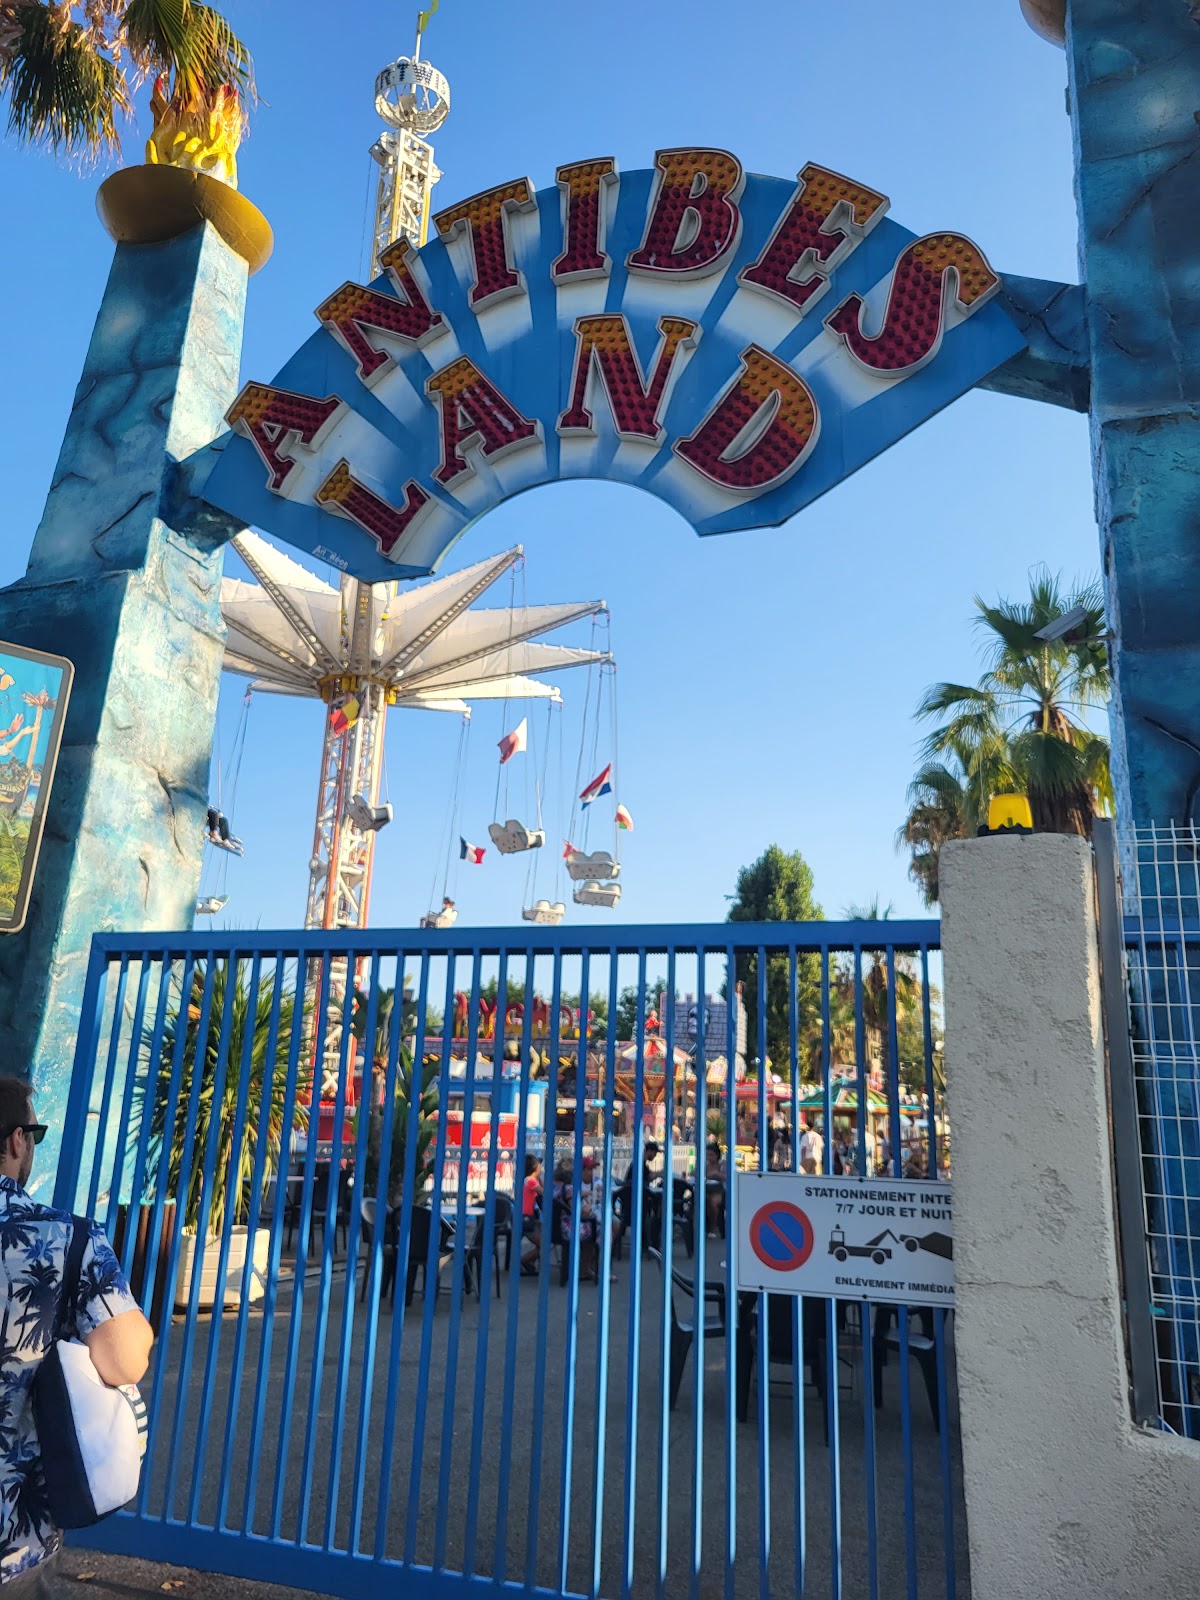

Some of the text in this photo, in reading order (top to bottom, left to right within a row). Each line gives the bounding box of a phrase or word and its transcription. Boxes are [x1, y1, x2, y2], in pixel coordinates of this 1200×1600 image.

[223, 147, 1001, 497] ANTIBES
[313, 312, 823, 563] LAND
[804, 1186, 917, 1204] STATIONNEMENT
[835, 1203, 854, 1215] 7/7
[858, 1204, 895, 1217] JOUR
[899, 1207, 916, 1218] ET
